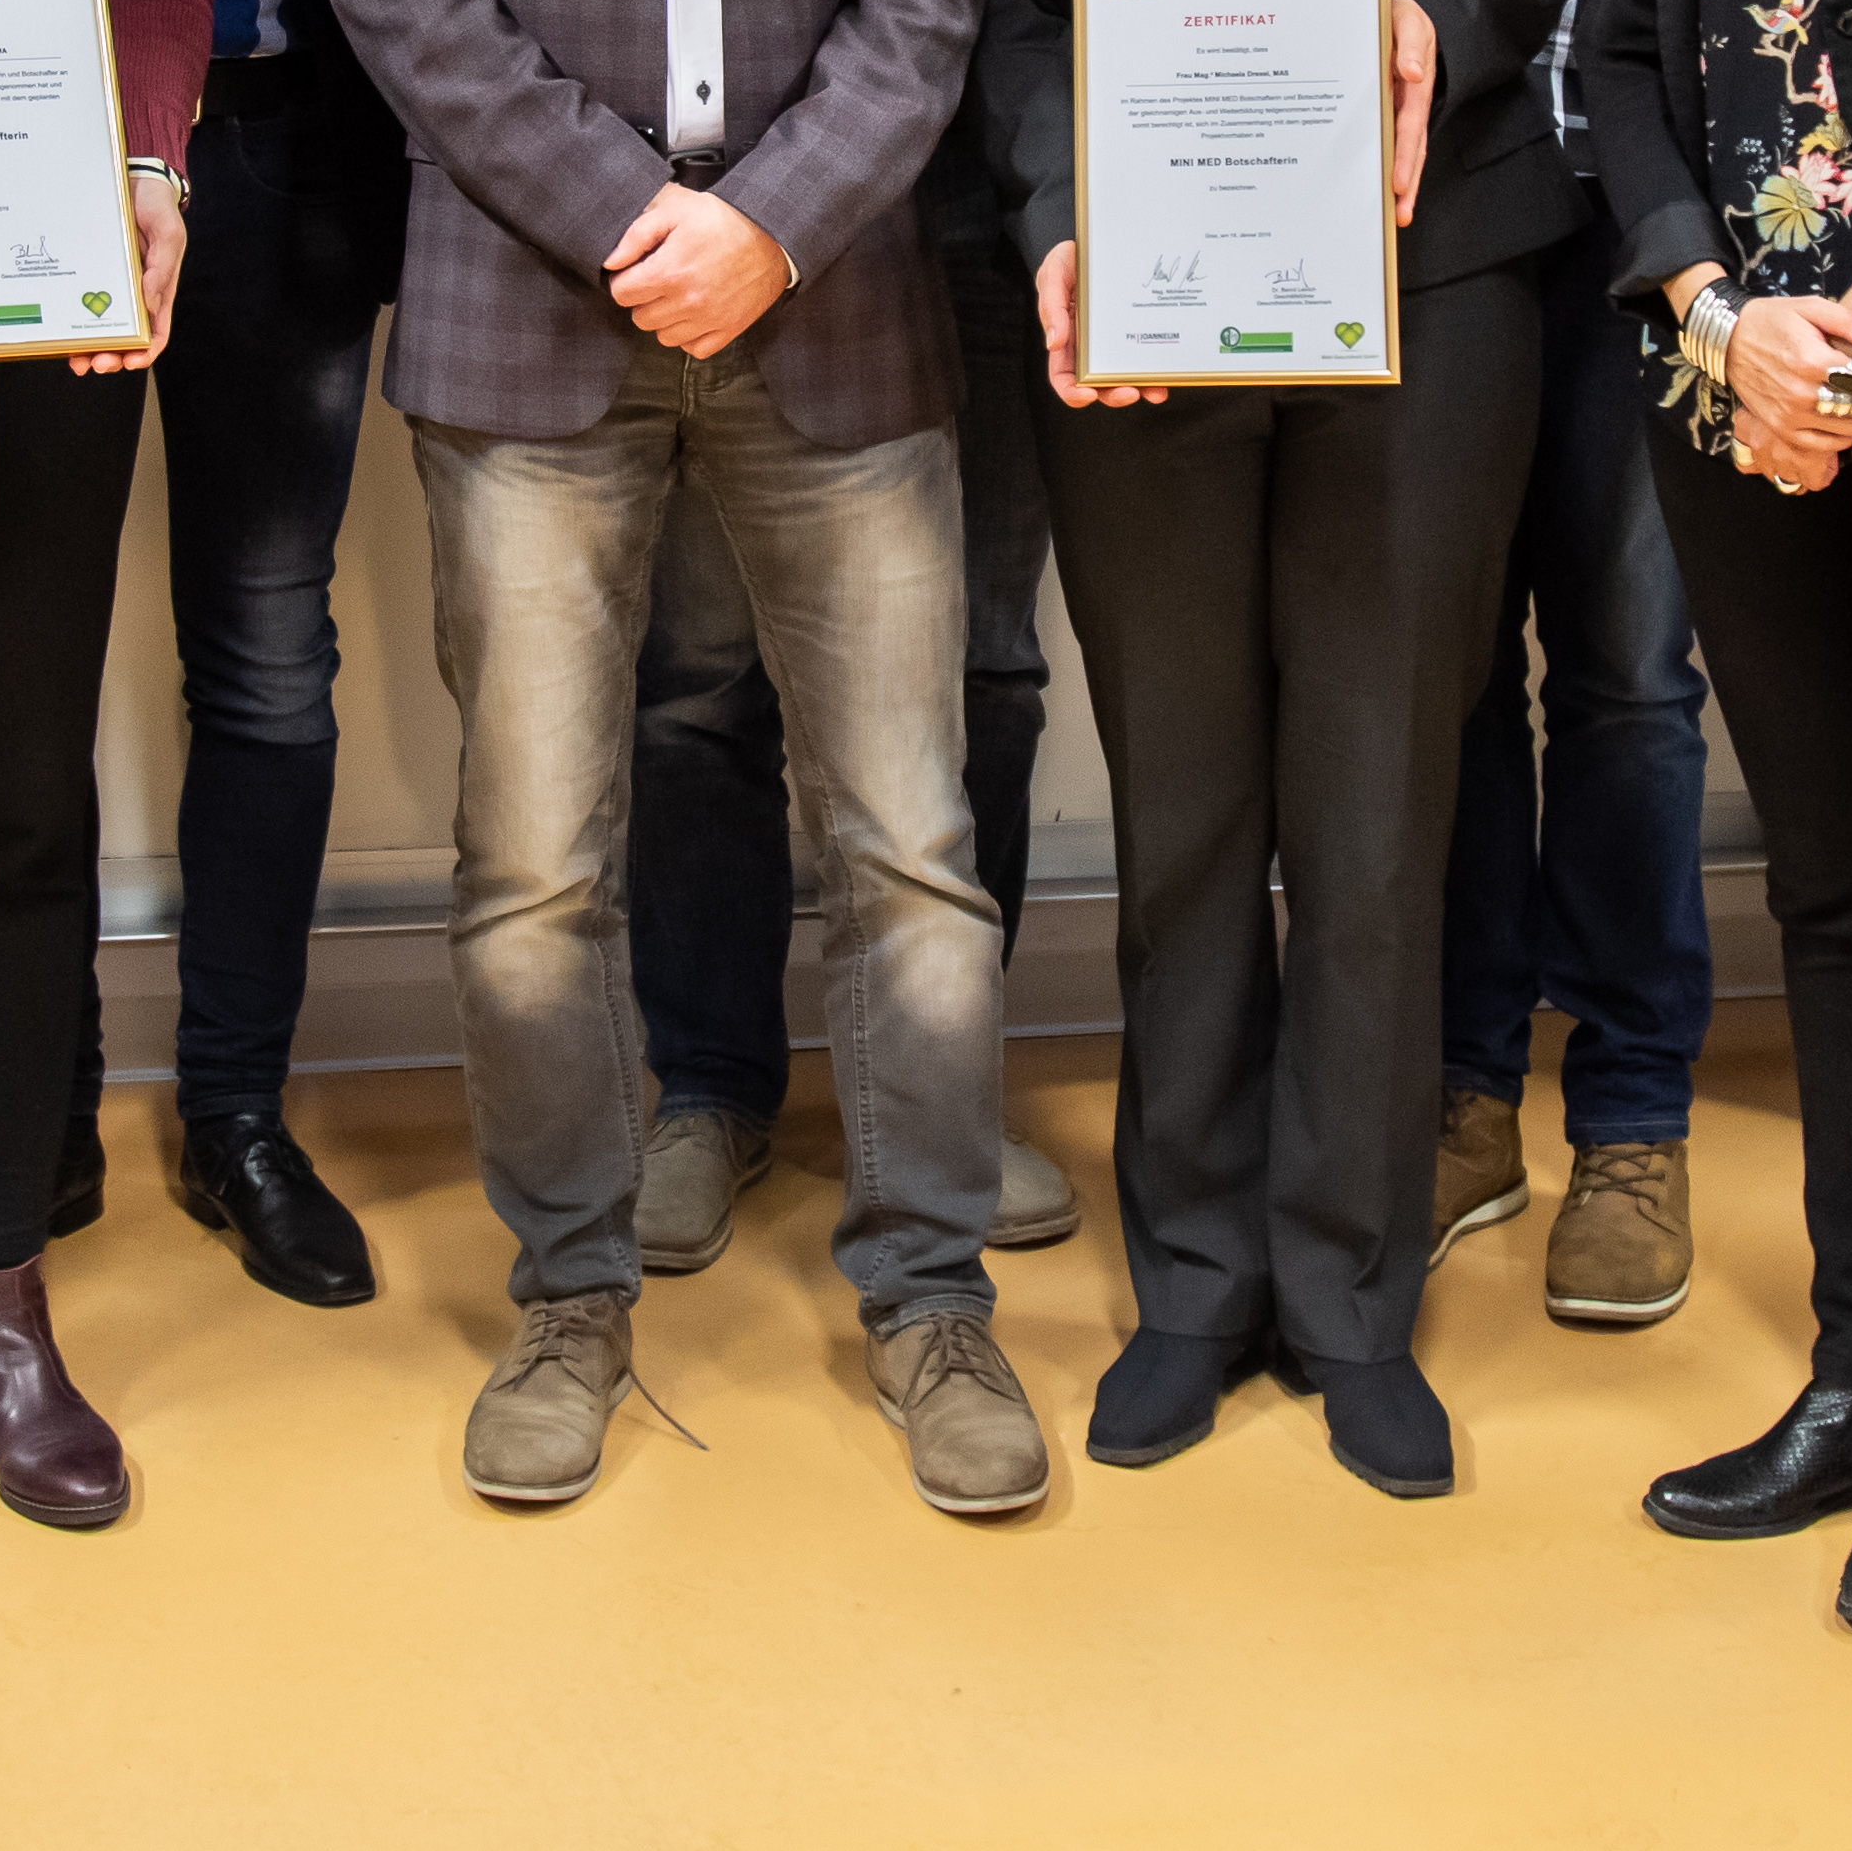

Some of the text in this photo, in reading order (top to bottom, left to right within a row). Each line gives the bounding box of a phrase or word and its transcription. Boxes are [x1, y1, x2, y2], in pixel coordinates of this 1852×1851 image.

[1182, 13, 1277, 27] ZERTIFIKAT
[1169, 155, 1298, 167] MINI MED Botschafterin
